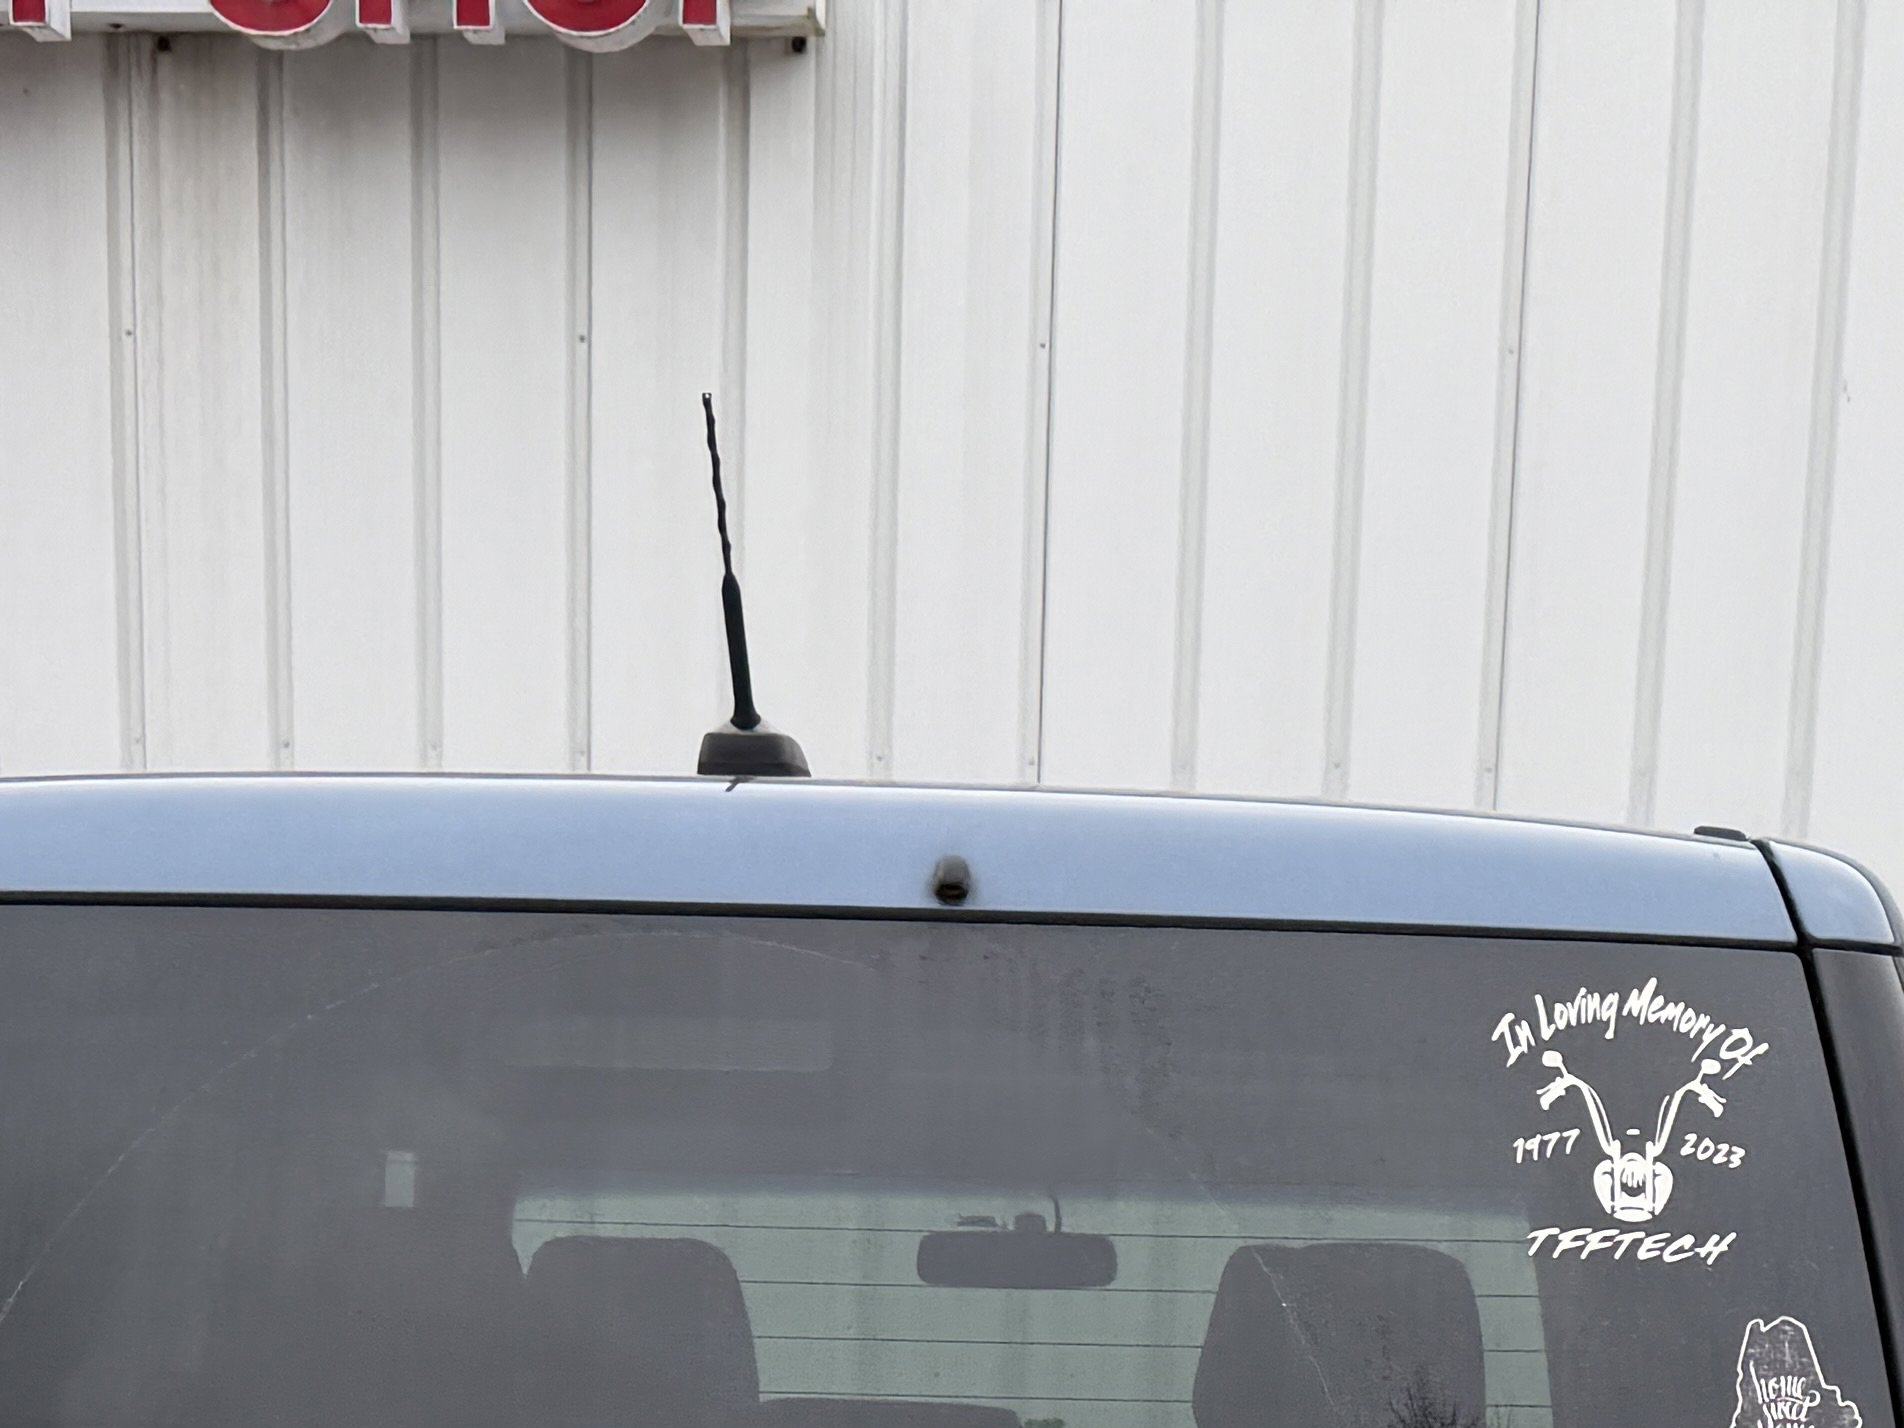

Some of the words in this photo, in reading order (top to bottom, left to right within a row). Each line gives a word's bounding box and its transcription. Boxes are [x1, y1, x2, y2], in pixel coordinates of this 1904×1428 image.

[1491, 1013, 1536, 1067] In
[1534, 987, 1620, 1040] Loving
[1622, 977, 1726, 1063] Memory
[1719, 1027, 1769, 1080] Of
[1513, 1128, 1581, 1163] 1977
[1680, 1133, 1746, 1168] 2023
[1526, 1227, 1737, 1264] TFFTECH
